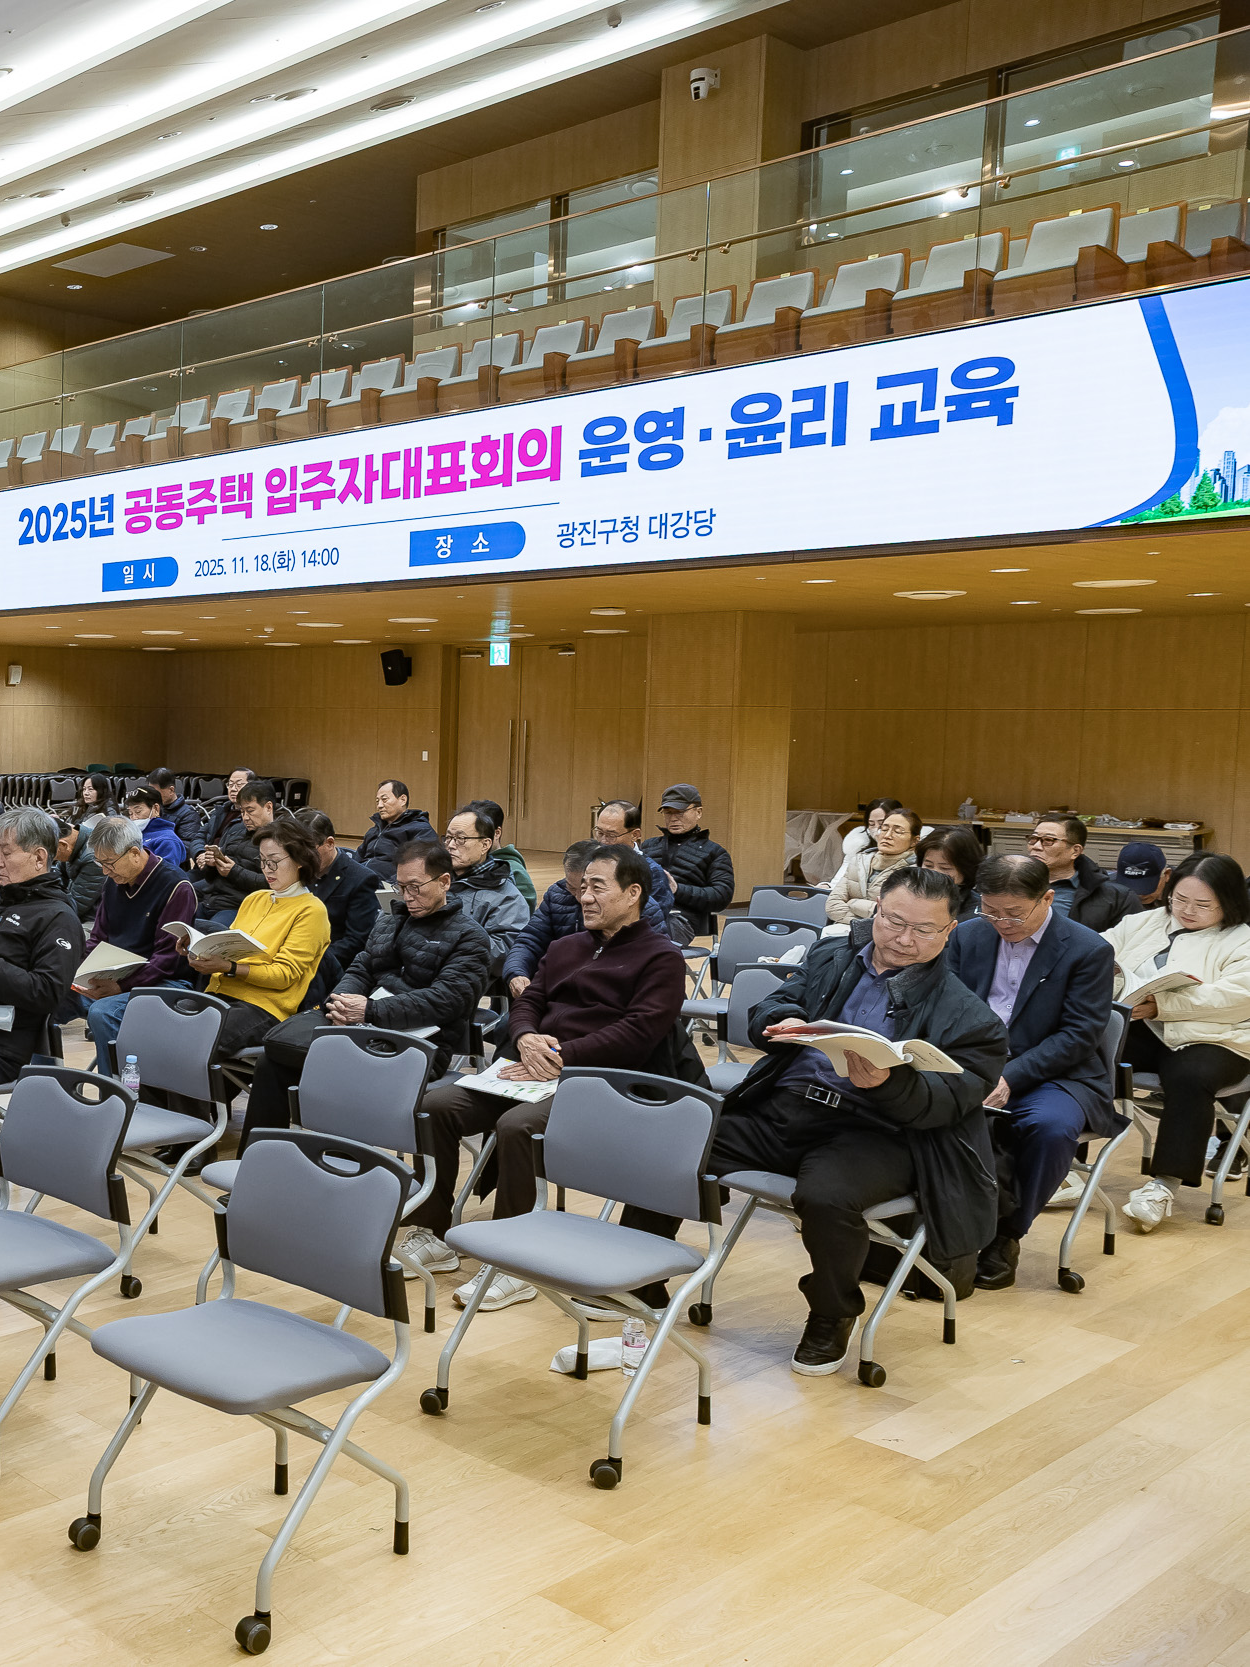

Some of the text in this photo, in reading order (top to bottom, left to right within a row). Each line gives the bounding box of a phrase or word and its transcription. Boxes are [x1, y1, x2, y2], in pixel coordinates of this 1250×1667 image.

[18, 494, 115, 546] 2025년
[125, 473, 253, 534] 공동주택
[266, 426, 563, 516] 입주자대표회의
[869, 357, 1020, 442] 교육
[556, 508, 717, 549] 광진구청 대강당
[194, 547, 340, 577] 2025. 11. 18.(화) 14:00
